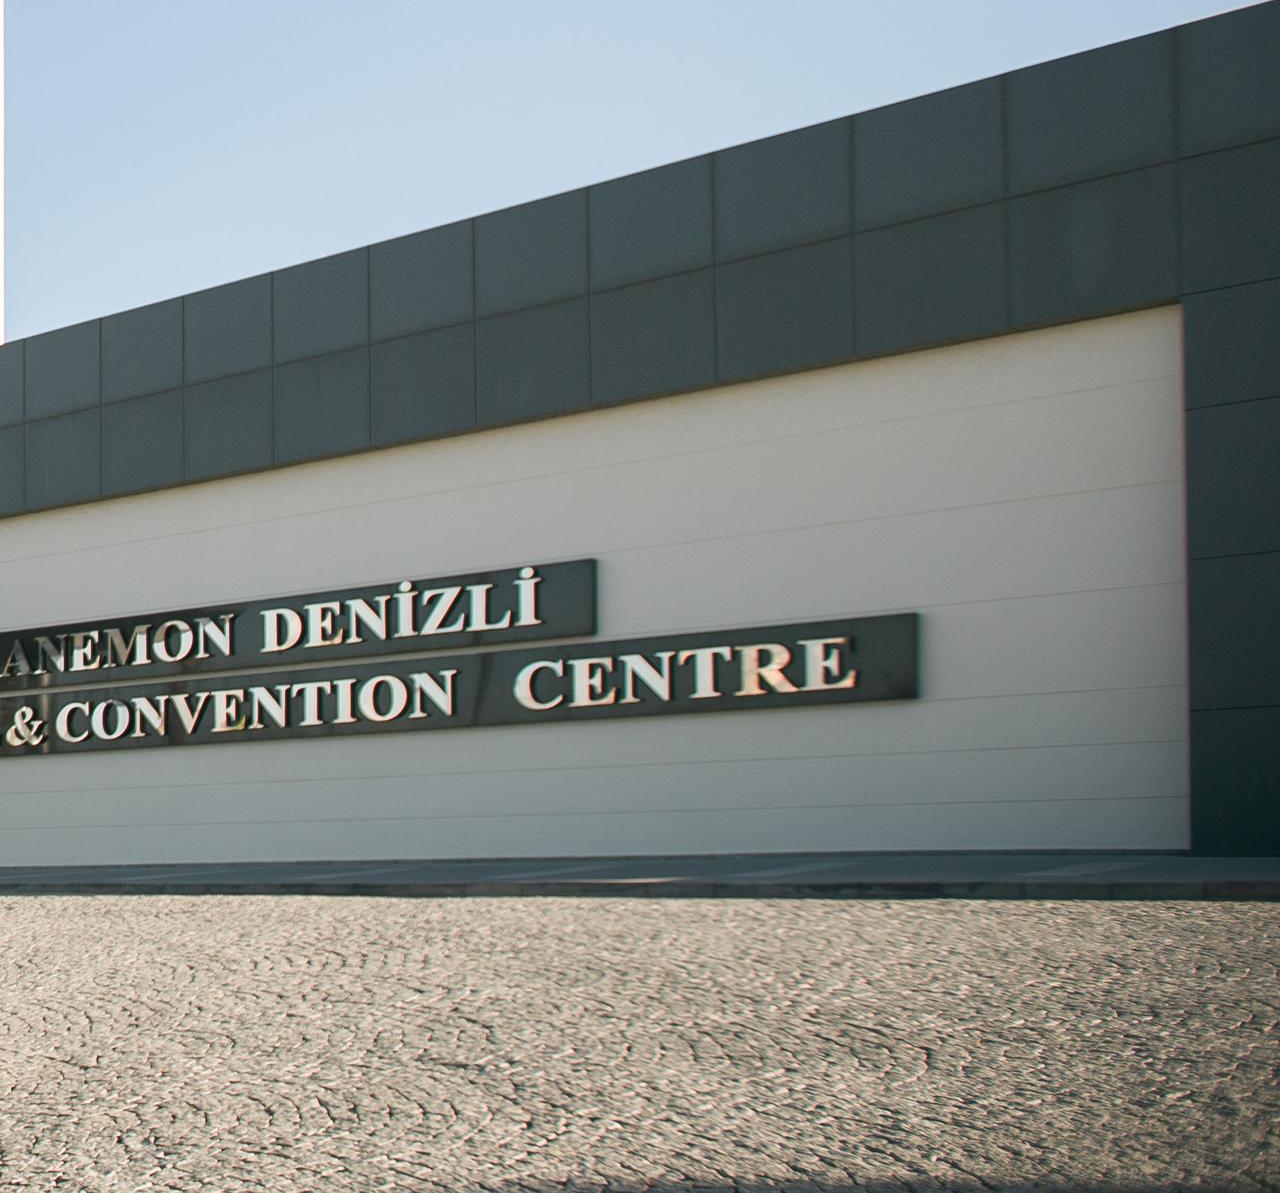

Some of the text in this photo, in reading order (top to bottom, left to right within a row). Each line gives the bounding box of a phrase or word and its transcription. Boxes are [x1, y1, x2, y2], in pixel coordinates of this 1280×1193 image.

[259, 566, 543, 653] DENİZLİ
[5, 705, 44, 747] &
[55, 668, 459, 744] CONVENTION
[512, 636, 857, 711] CENTRE
